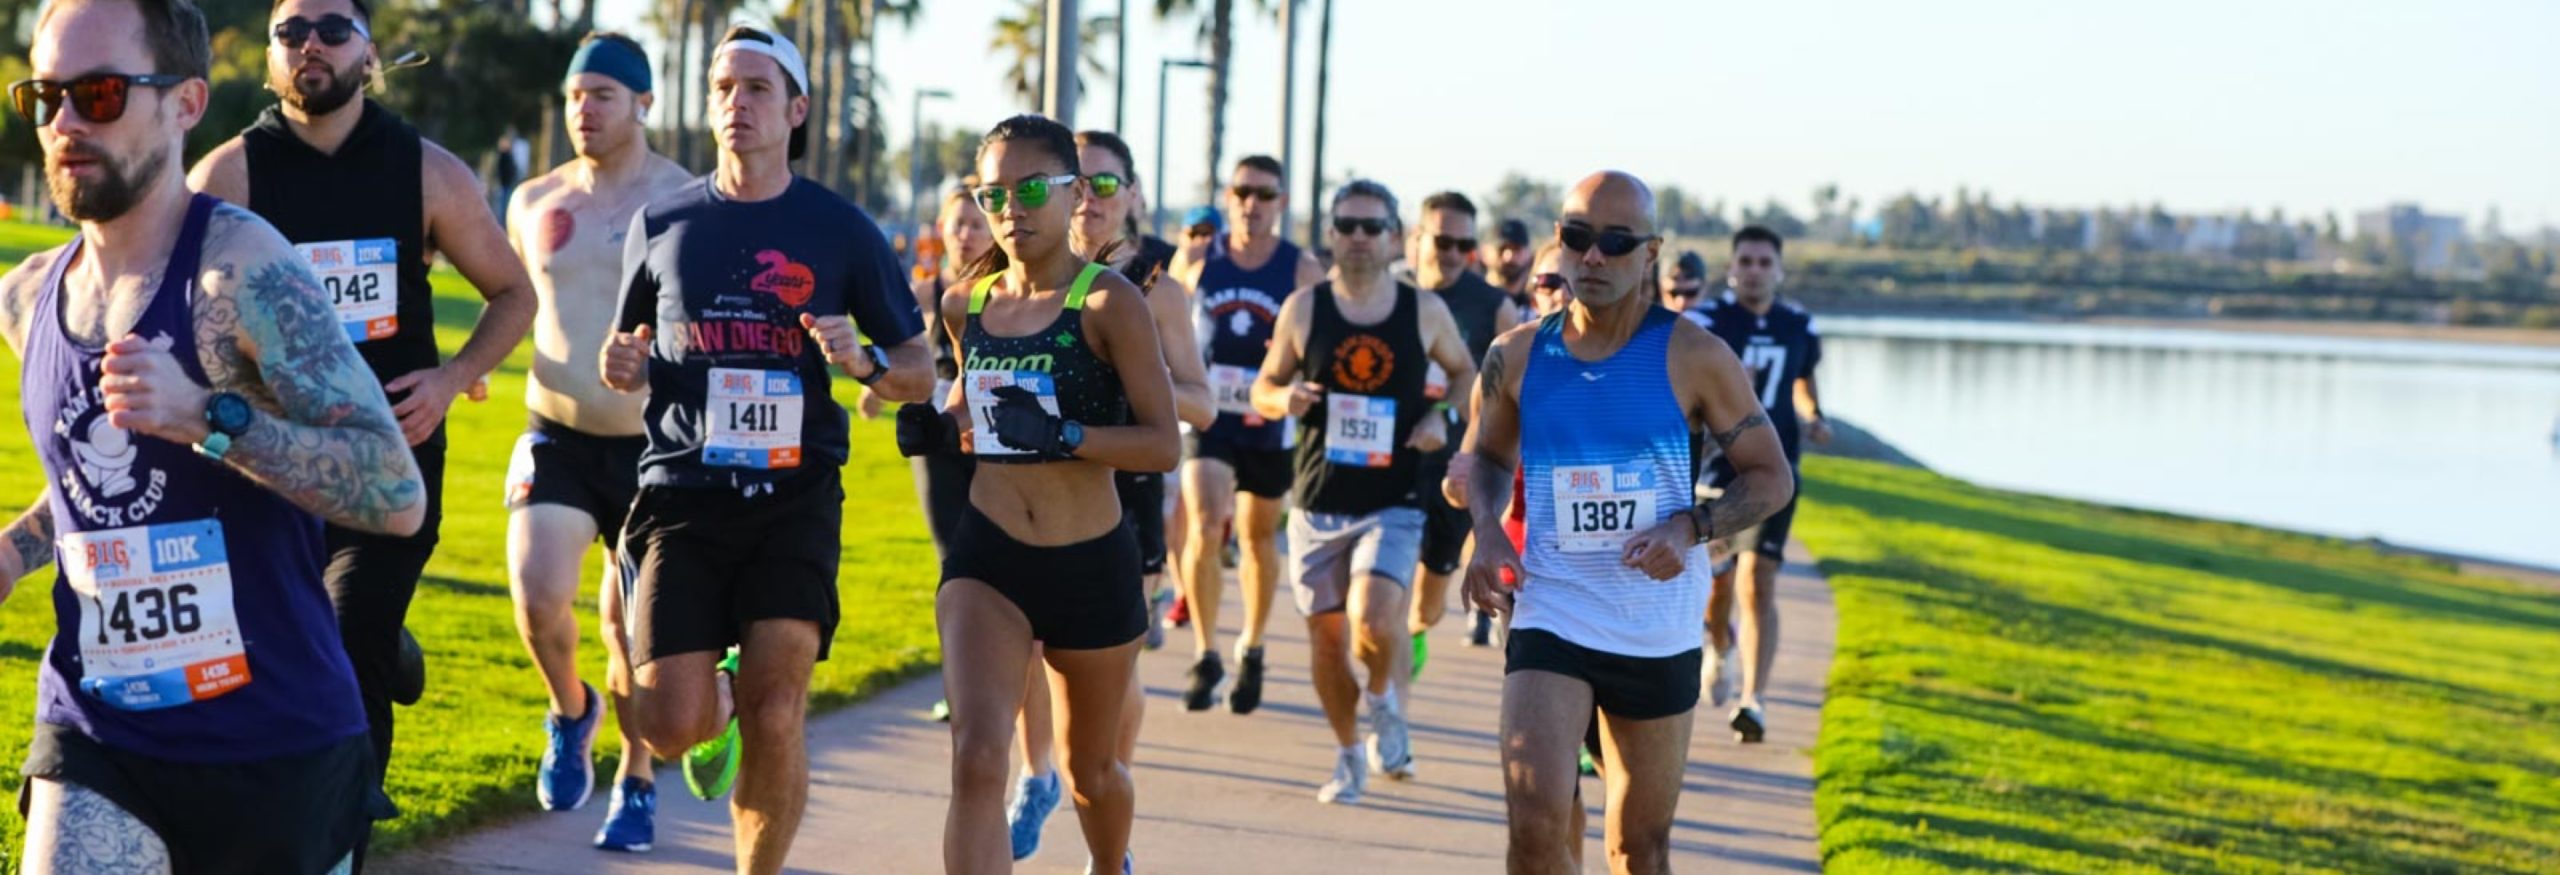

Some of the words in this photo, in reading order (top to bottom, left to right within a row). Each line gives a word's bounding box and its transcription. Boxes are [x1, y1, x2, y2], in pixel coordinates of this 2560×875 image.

[673, 321, 724, 353] SAN
[731, 322, 803, 357] DIEGO
[965, 347, 1054, 374] boom
[767, 378, 791, 393] 10K
[729, 402, 777, 431] 1411
[1341, 418, 1377, 441] 1531
[128, 467, 167, 522] CLUB
[1570, 471, 1600, 490] BIG
[1616, 472, 1641, 488] 10K
[1572, 499, 1637, 532] 1387
[85, 539, 131, 572] BIG
[155, 535, 200, 565] 10K
[93, 583, 202, 645] 1436
